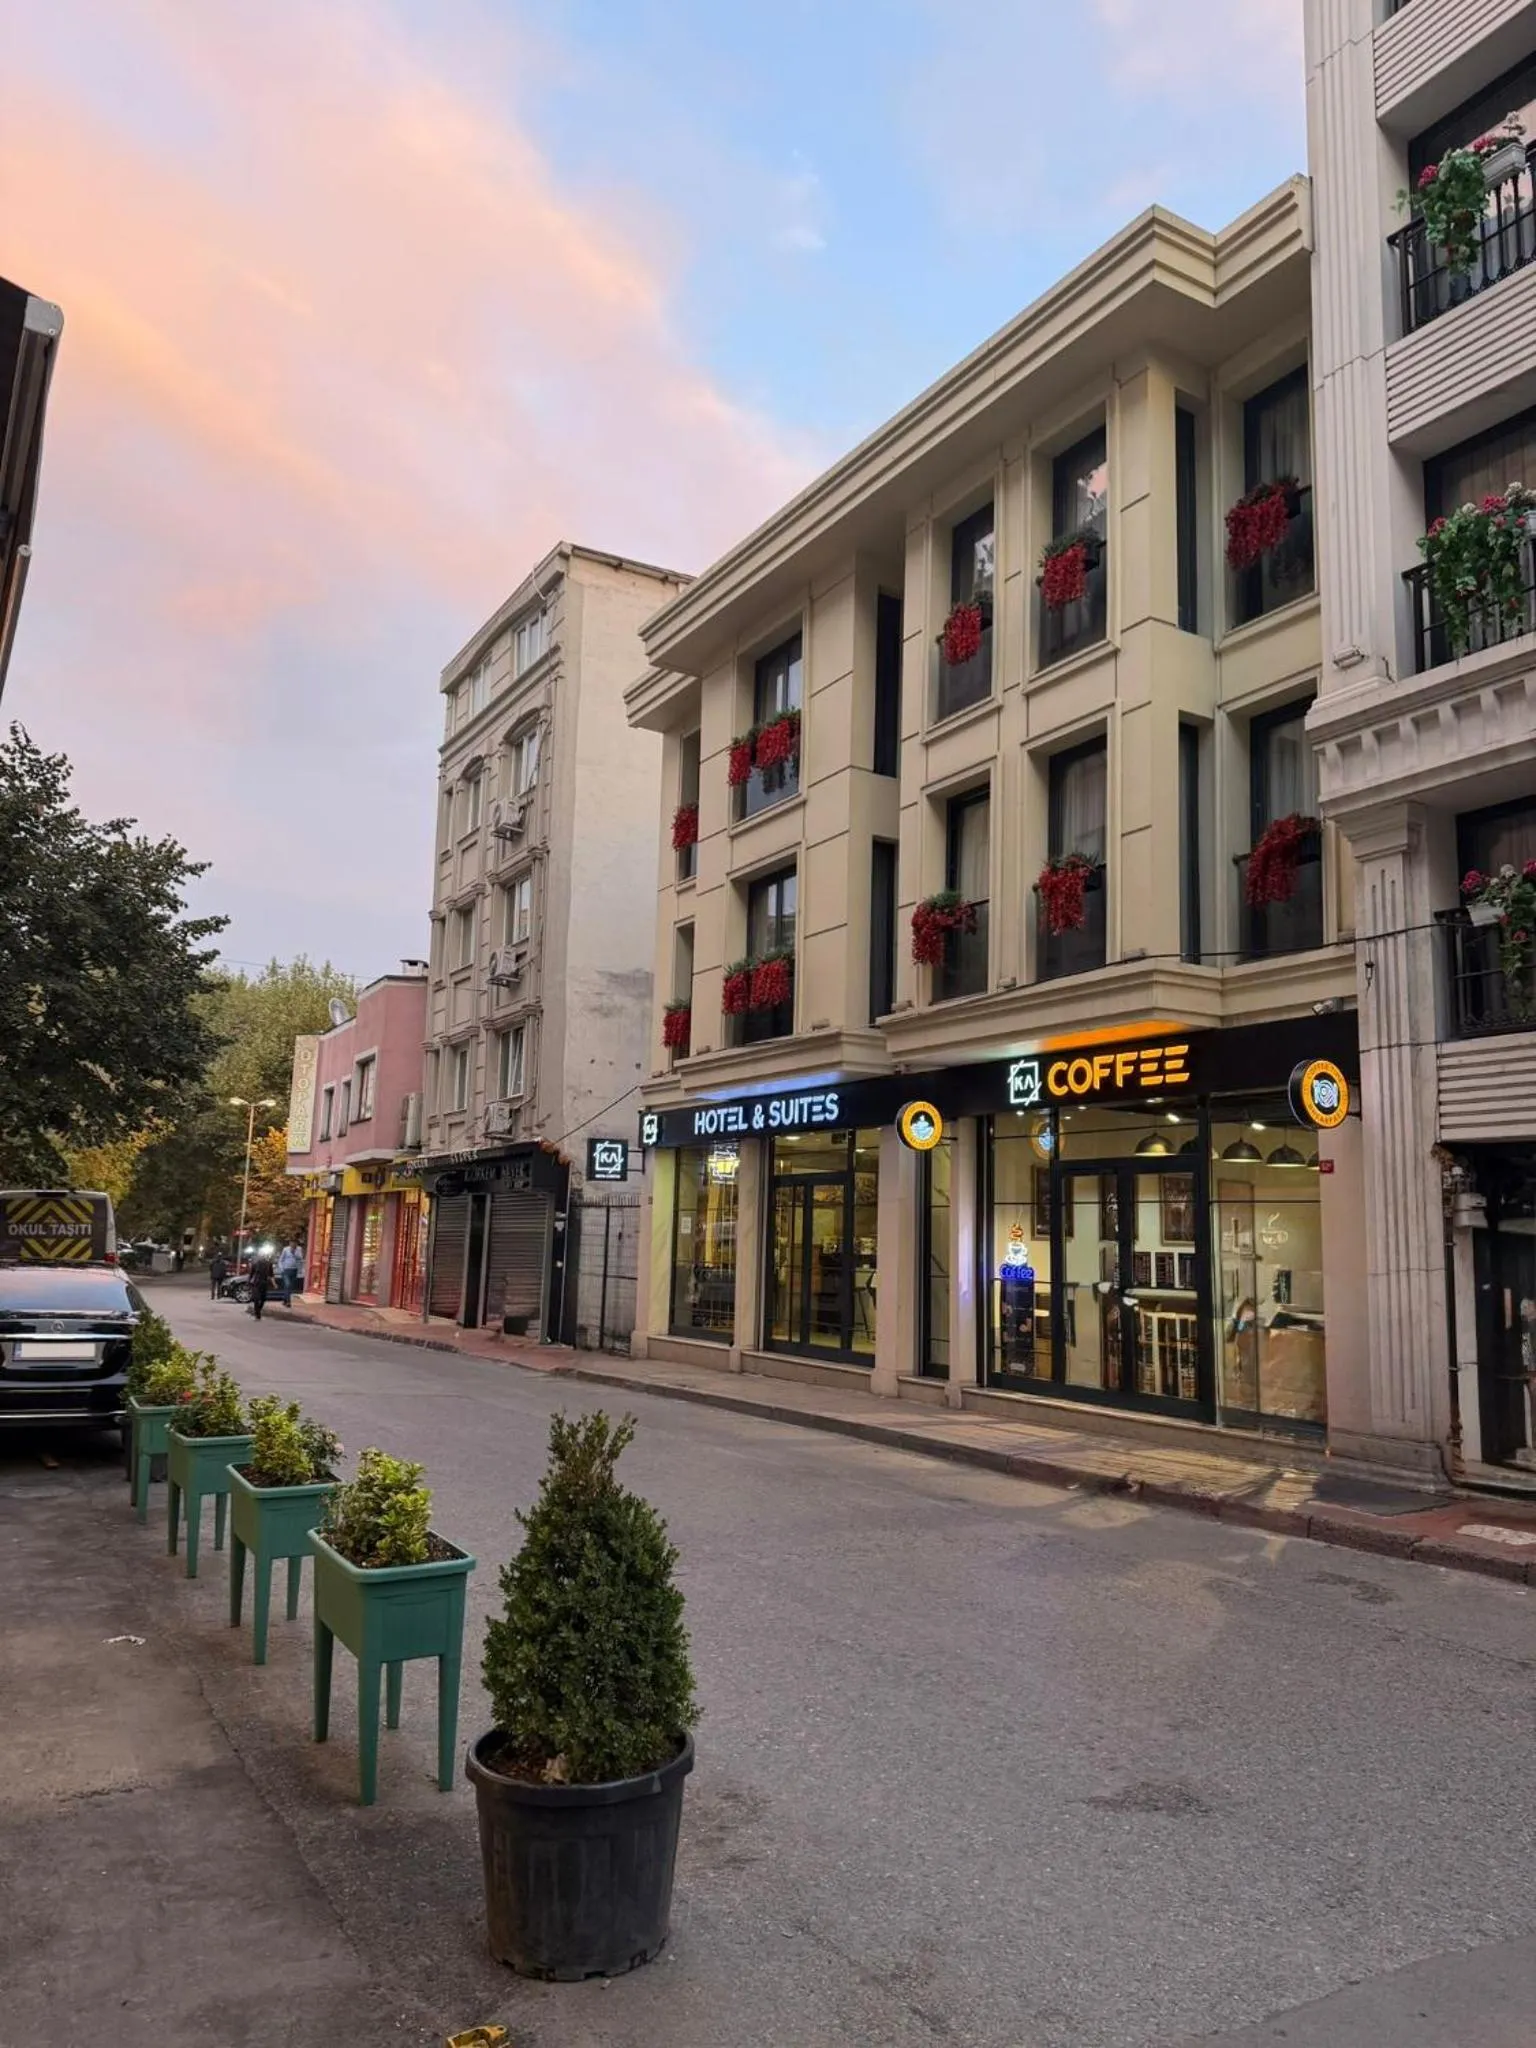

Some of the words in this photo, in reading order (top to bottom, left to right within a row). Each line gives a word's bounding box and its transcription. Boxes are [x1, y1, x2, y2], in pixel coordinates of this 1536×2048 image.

[1047, 1045, 1190, 1096] COFFEE
[694, 1106, 748, 1135] HOTEL
[752, 1104, 765, 1130] &
[768, 1092, 839, 1126] SUITES
[8, 1223, 46, 1235] OKUL
[50, 1223, 92, 1237] TAŞITI
